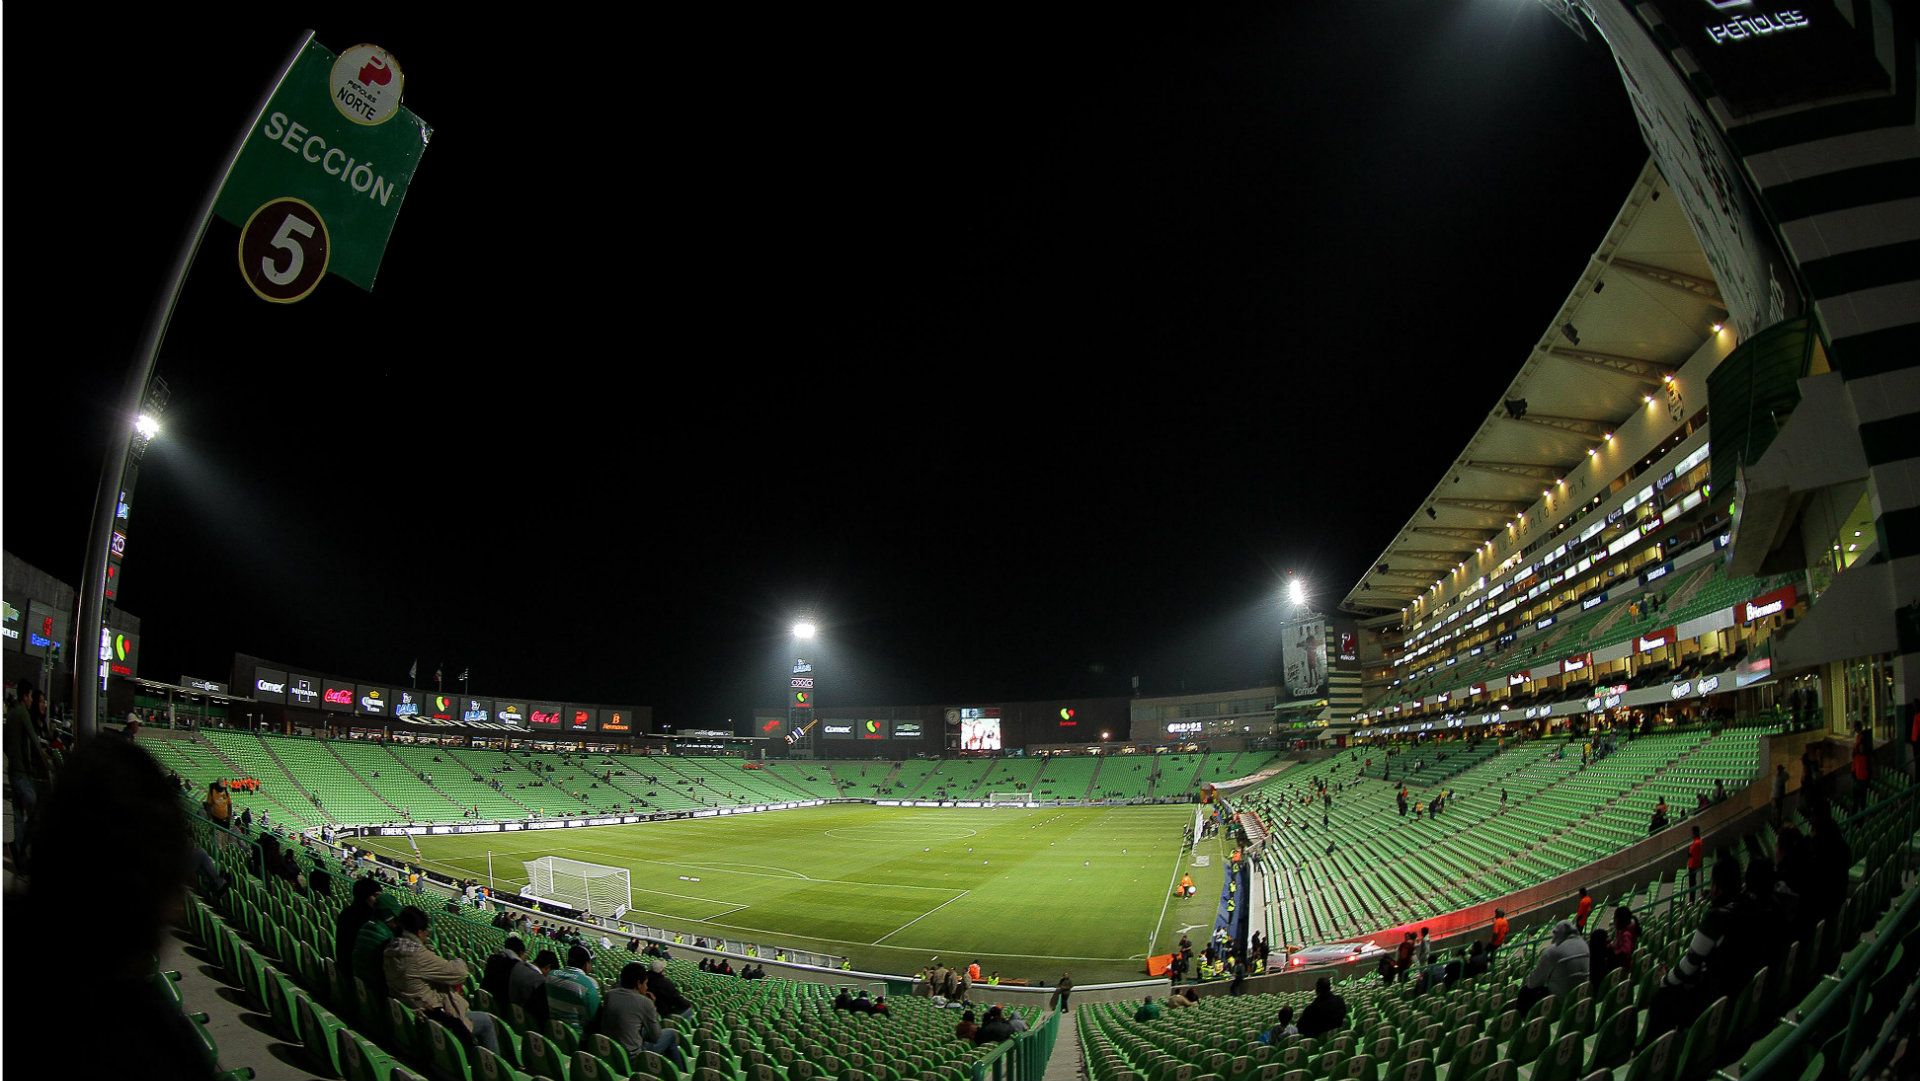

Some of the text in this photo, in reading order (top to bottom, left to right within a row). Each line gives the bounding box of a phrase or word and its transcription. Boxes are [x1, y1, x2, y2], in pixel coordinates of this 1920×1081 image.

[1706, 10, 1808, 43] PEÑOLES
[336, 87, 376, 121] NORTE
[264, 112, 394, 207] SECCIÓN
[262, 213, 316, 286] 5
[256, 679, 286, 694] Comex
[791, 679, 813, 688] OXXO
[1292, 685, 1318, 698] Comex
[824, 724, 852, 734] Comex
